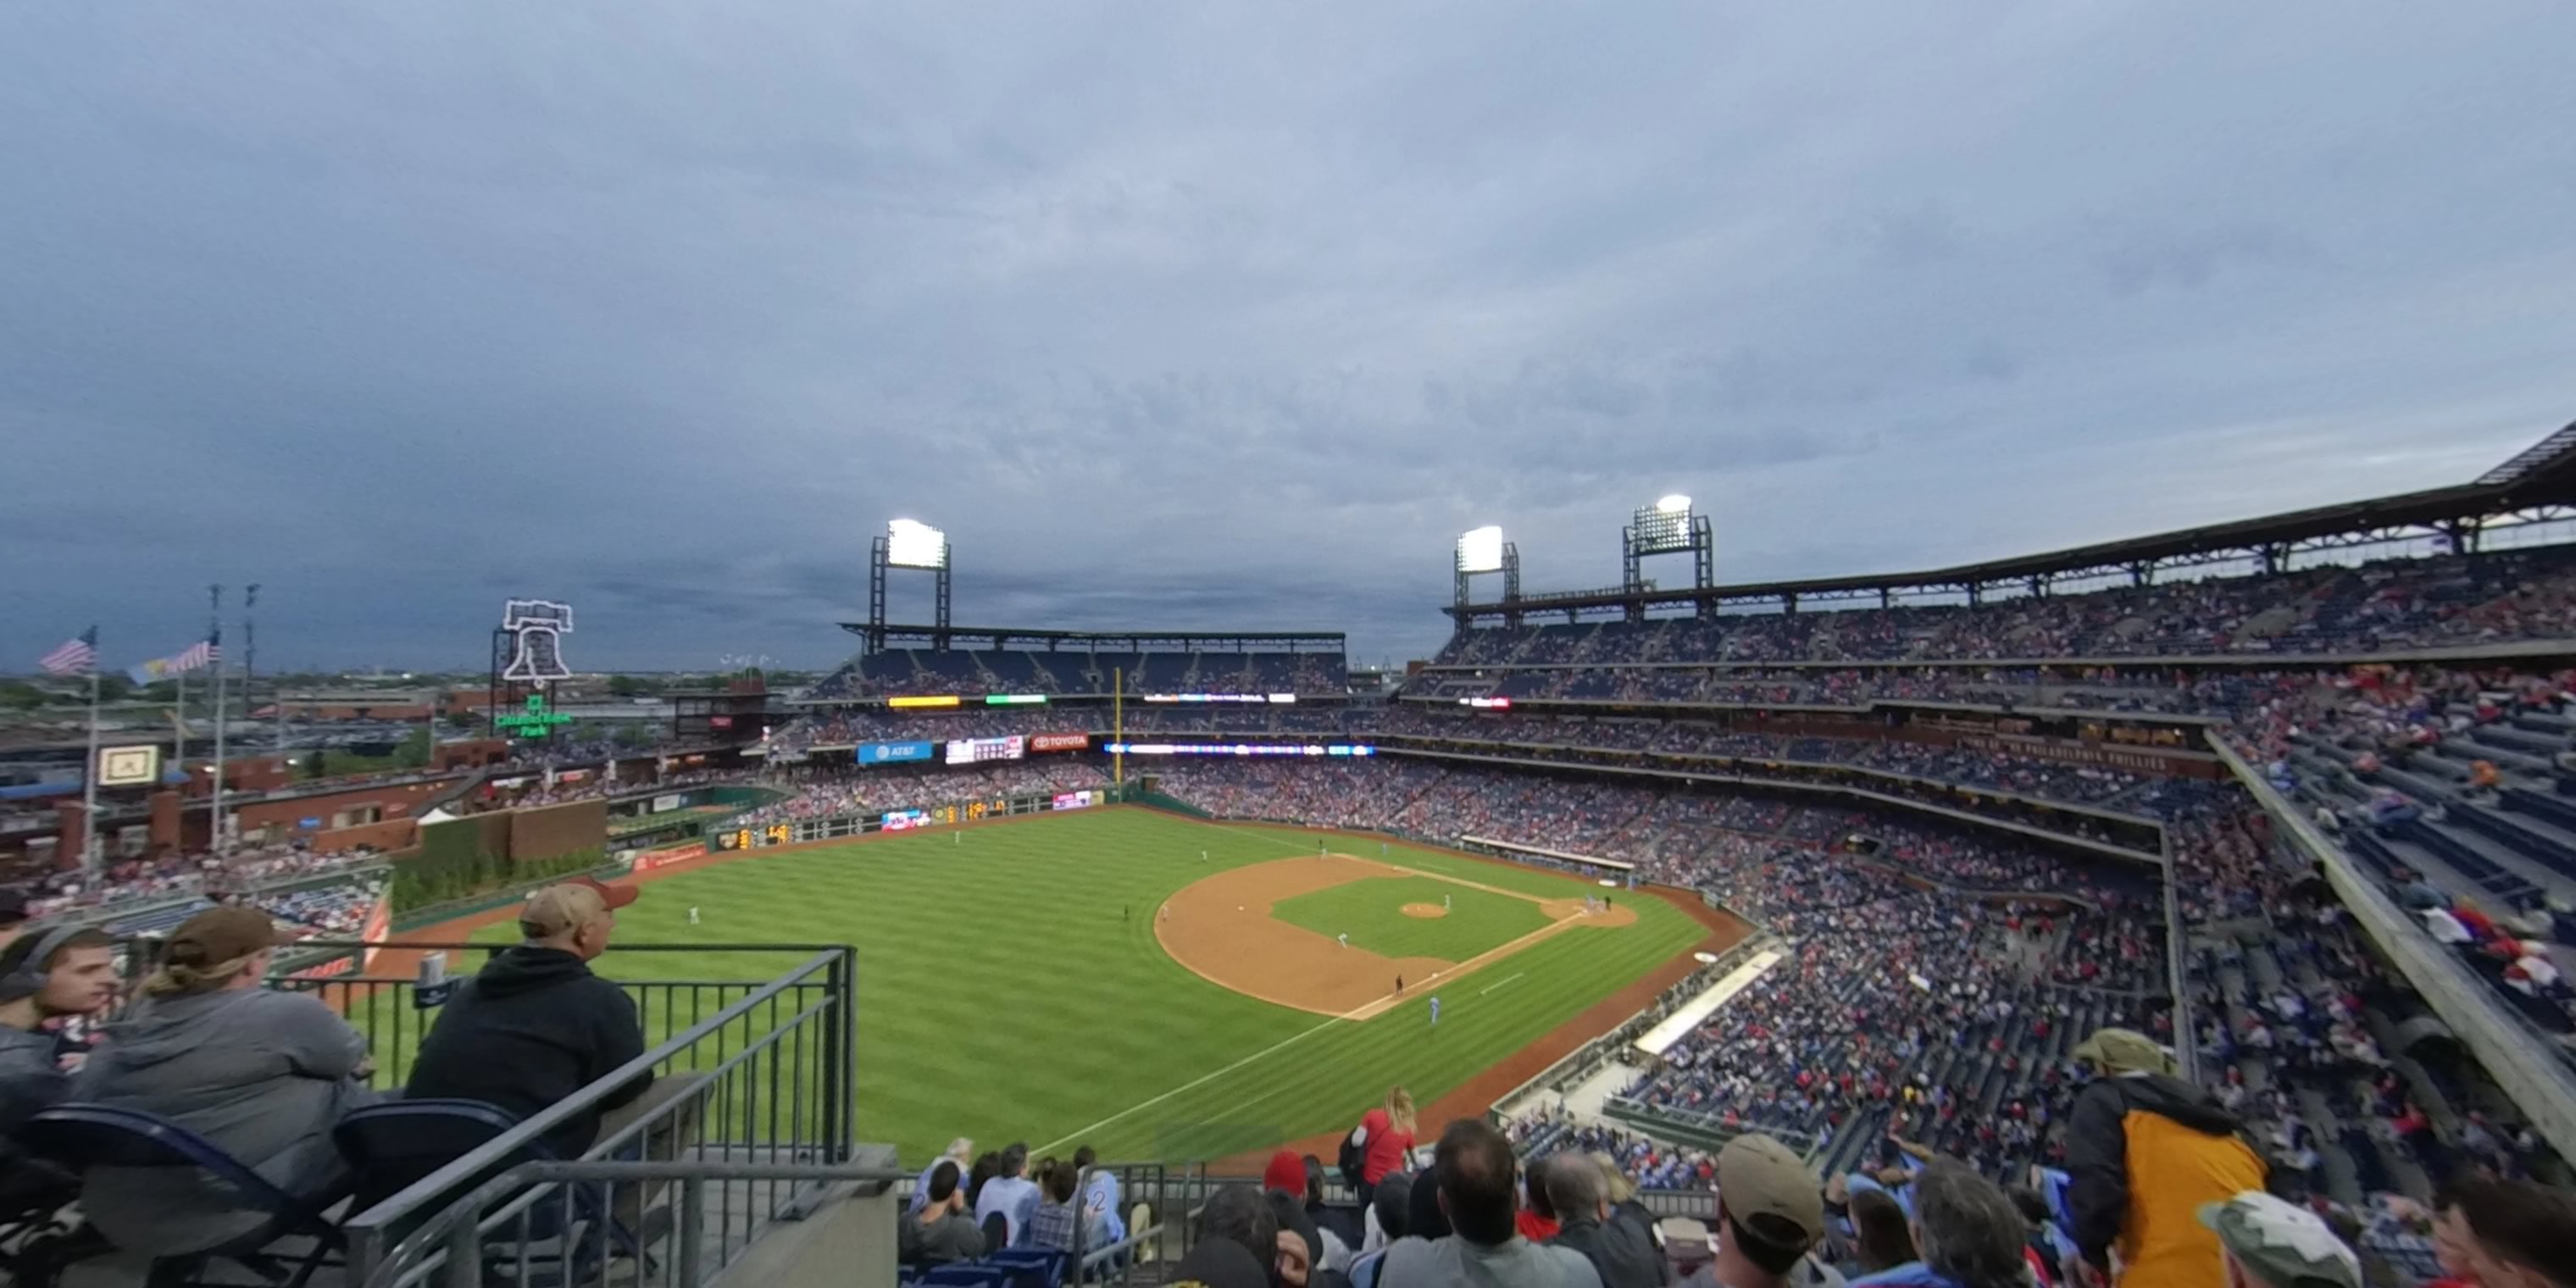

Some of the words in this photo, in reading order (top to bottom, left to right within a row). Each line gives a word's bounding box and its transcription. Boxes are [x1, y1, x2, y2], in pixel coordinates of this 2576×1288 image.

[1050, 736, 1085, 747] TOYOTA
[891, 746, 914, 756] AT&T
[2107, 752, 2167, 770] PHILLIES
